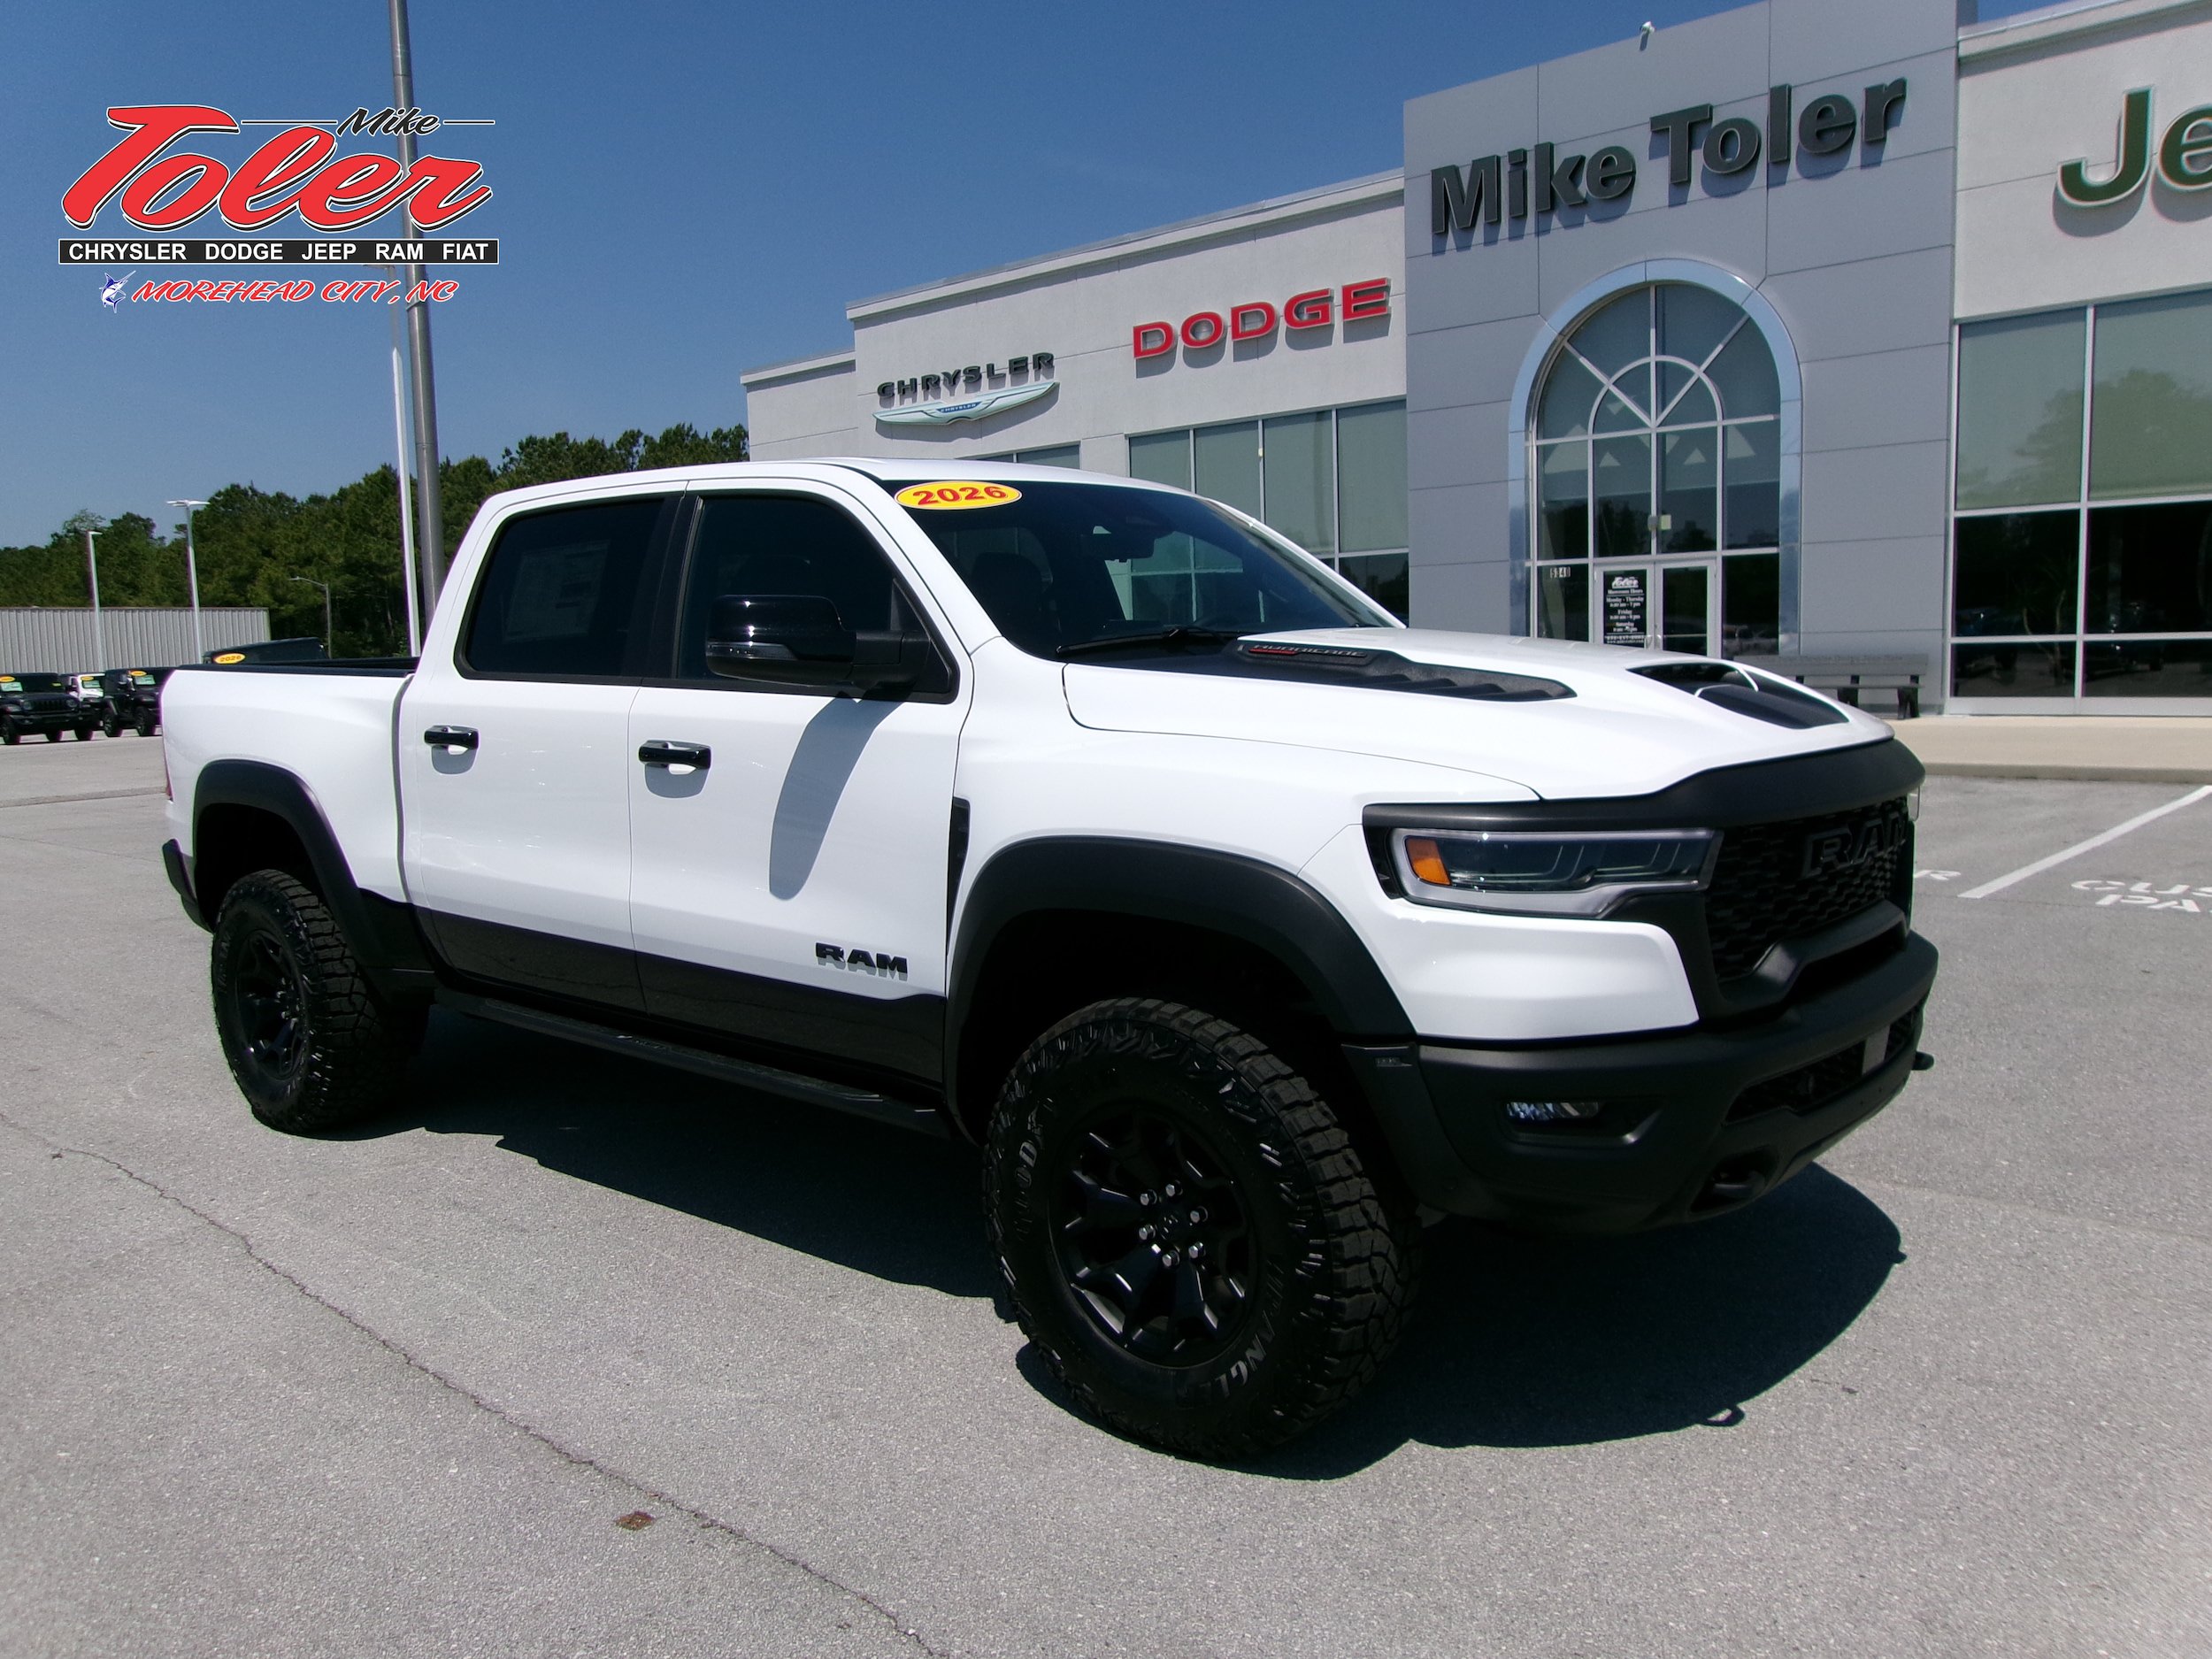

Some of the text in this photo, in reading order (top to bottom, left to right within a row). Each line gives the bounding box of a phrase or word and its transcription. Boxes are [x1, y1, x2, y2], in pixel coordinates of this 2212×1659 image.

[1431, 77, 1908, 235] Mike Toler
[2057, 85, 2212, 207] Je
[1133, 277, 1392, 359] DODGE
[877, 352, 1056, 399] CHRYSLER
[912, 486, 1008, 506] 2026
[2095, 894, 2212, 913] PA
[816, 942, 908, 974] RAM
